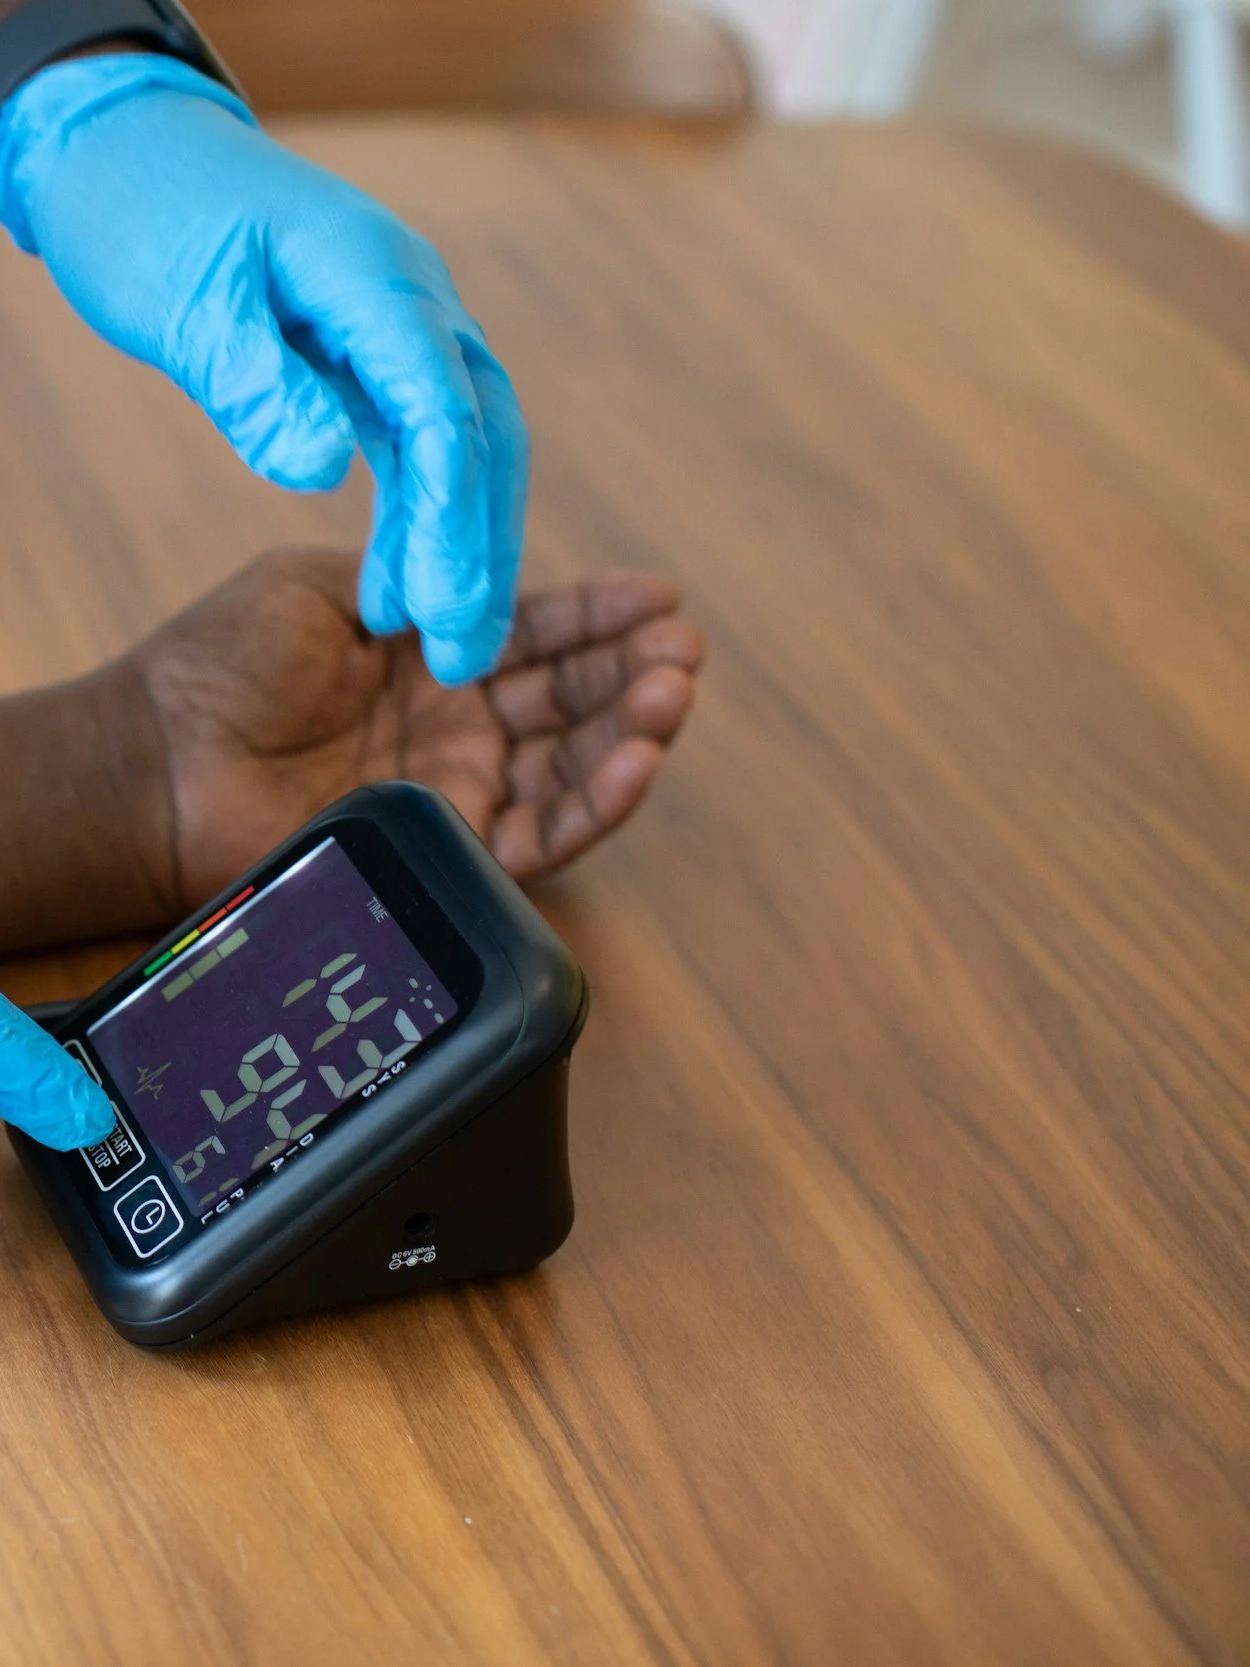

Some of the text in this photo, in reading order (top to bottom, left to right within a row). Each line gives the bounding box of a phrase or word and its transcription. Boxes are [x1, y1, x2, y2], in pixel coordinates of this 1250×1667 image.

[366, 896, 388, 923] TIME
[282, 953, 422, 1099] 143
[362, 1060, 406, 1097] SYS
[200, 1033, 328, 1169] 94
[109, 1123, 133, 1157] TART
[269, 1132, 314, 1172] DIA
[172, 1135, 239, 1207] 61
[201, 1188, 244, 1225] PUL
[391, 1252, 402, 1260] DC
